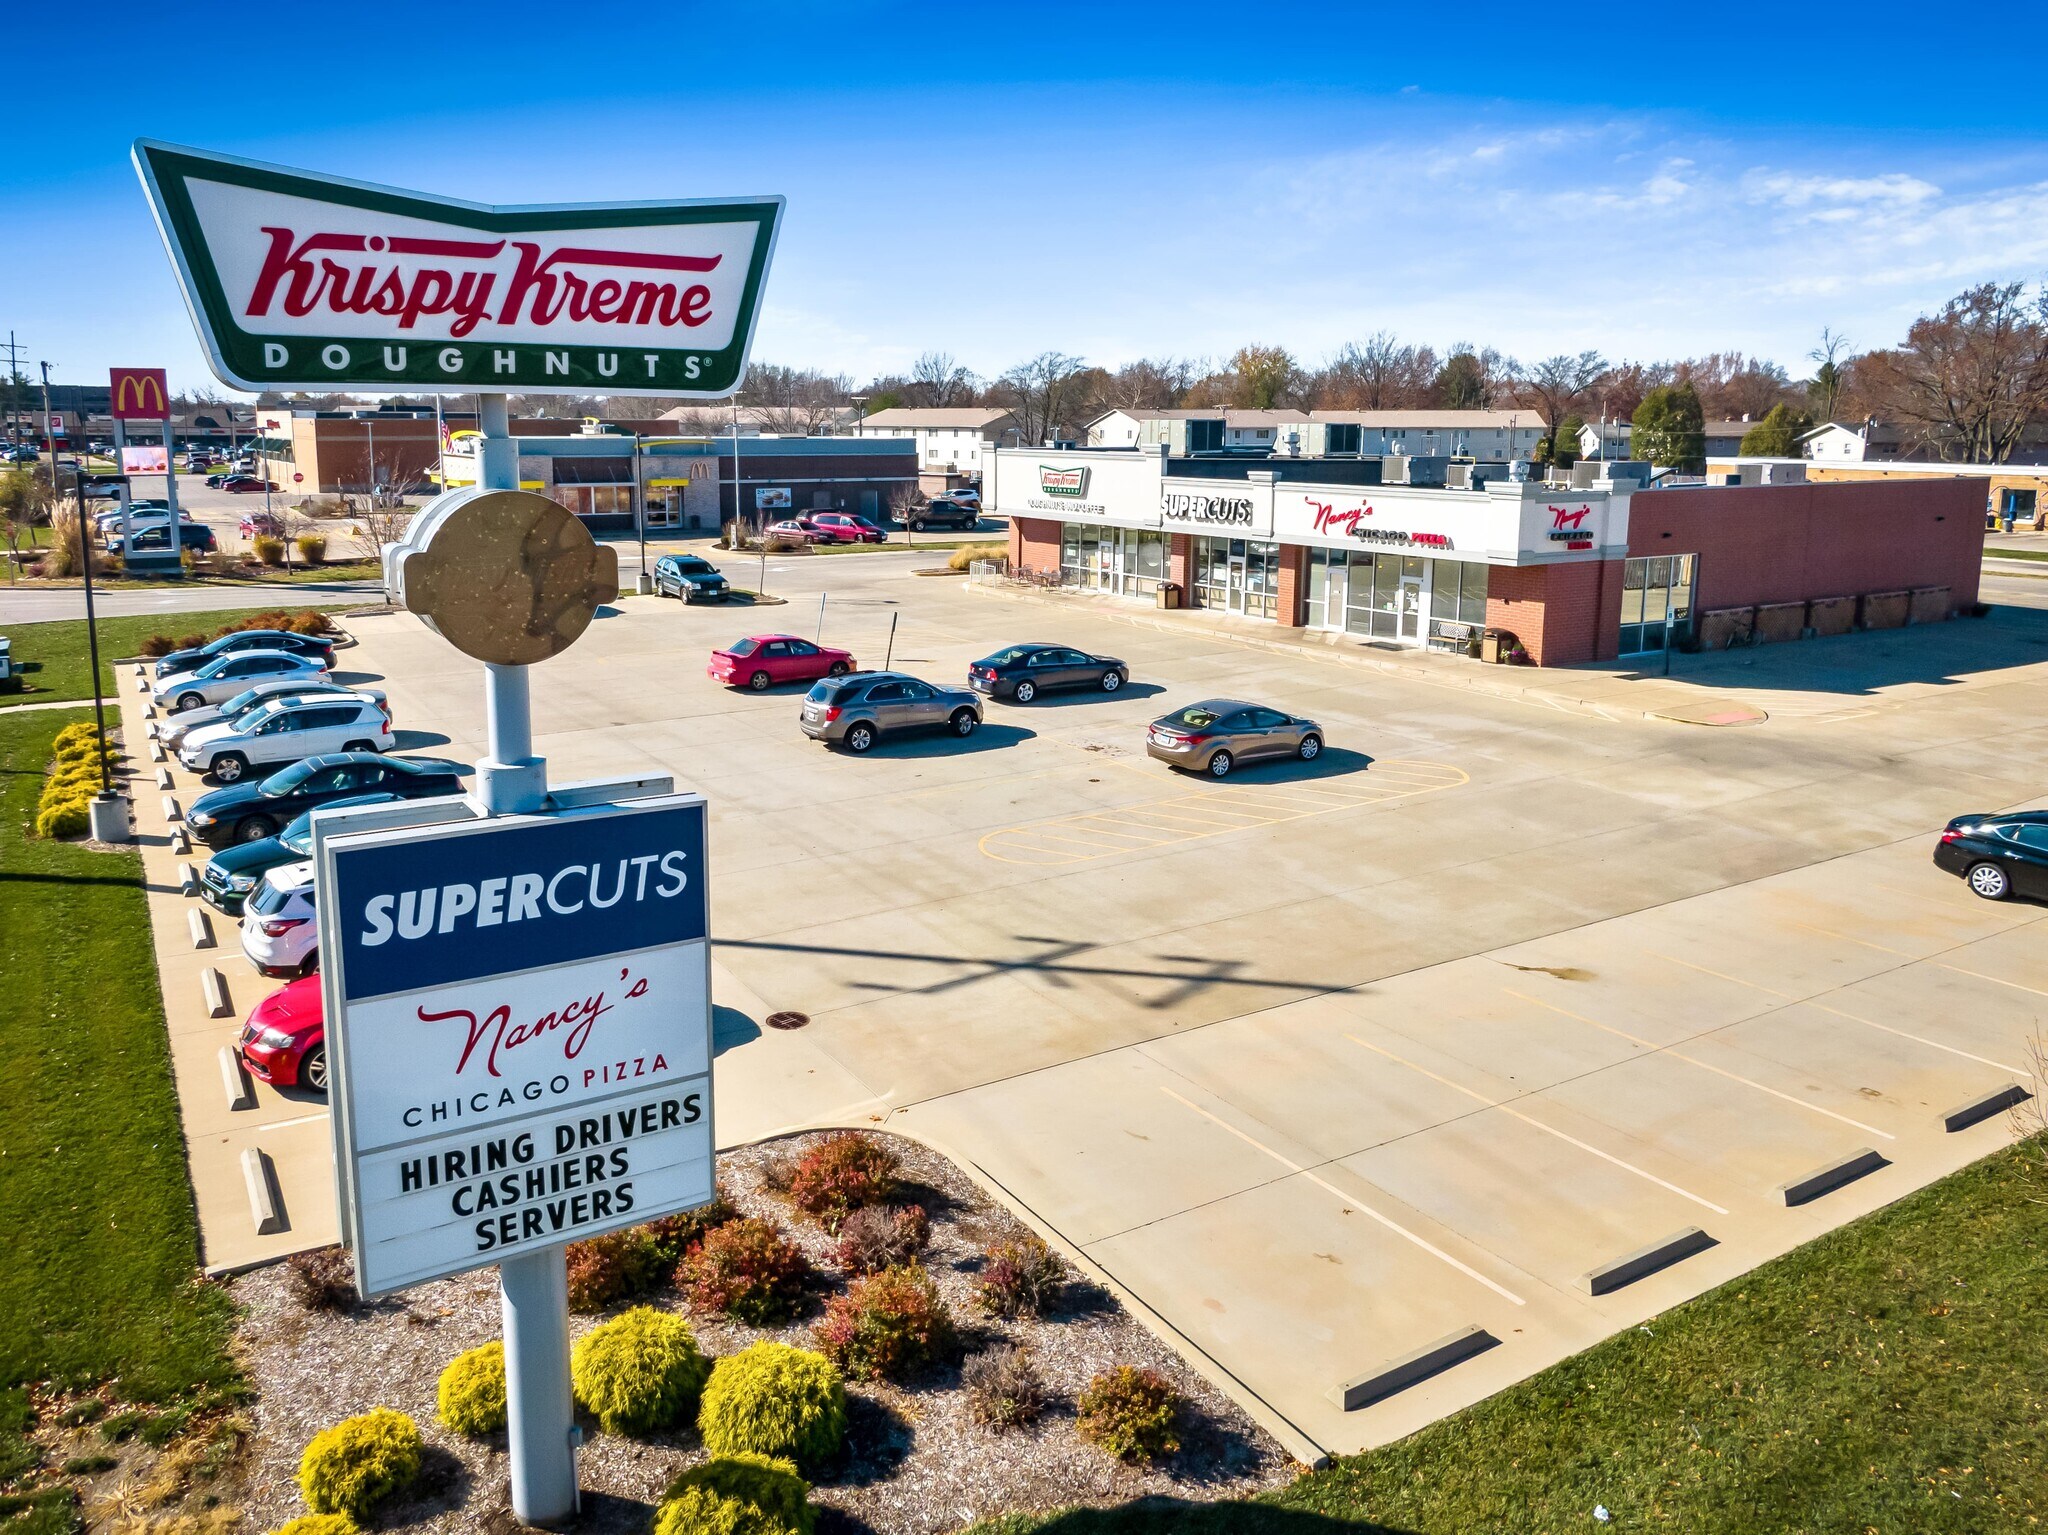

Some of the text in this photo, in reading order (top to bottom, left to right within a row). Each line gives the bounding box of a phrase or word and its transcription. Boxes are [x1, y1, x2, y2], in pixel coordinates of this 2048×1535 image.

[245, 226, 723, 338] Krispy Kreme
[264, 342, 701, 380] DOUGHNUTS
[1160, 494, 1251, 522] SUPERCUTS
[1304, 495, 1373, 537] Nancy's
[1351, 527, 1409, 542] CHICAGO
[360, 849, 689, 947] SUPERCUTS
[417, 967, 650, 1077] Nancy's
[402, 1053, 670, 1128] CHICAGO PIZZA
[400, 1093, 702, 1193] HIRING DRIVERS
[451, 1146, 631, 1217] CASHIERS
[475, 1182, 635, 1252] SERVERS
